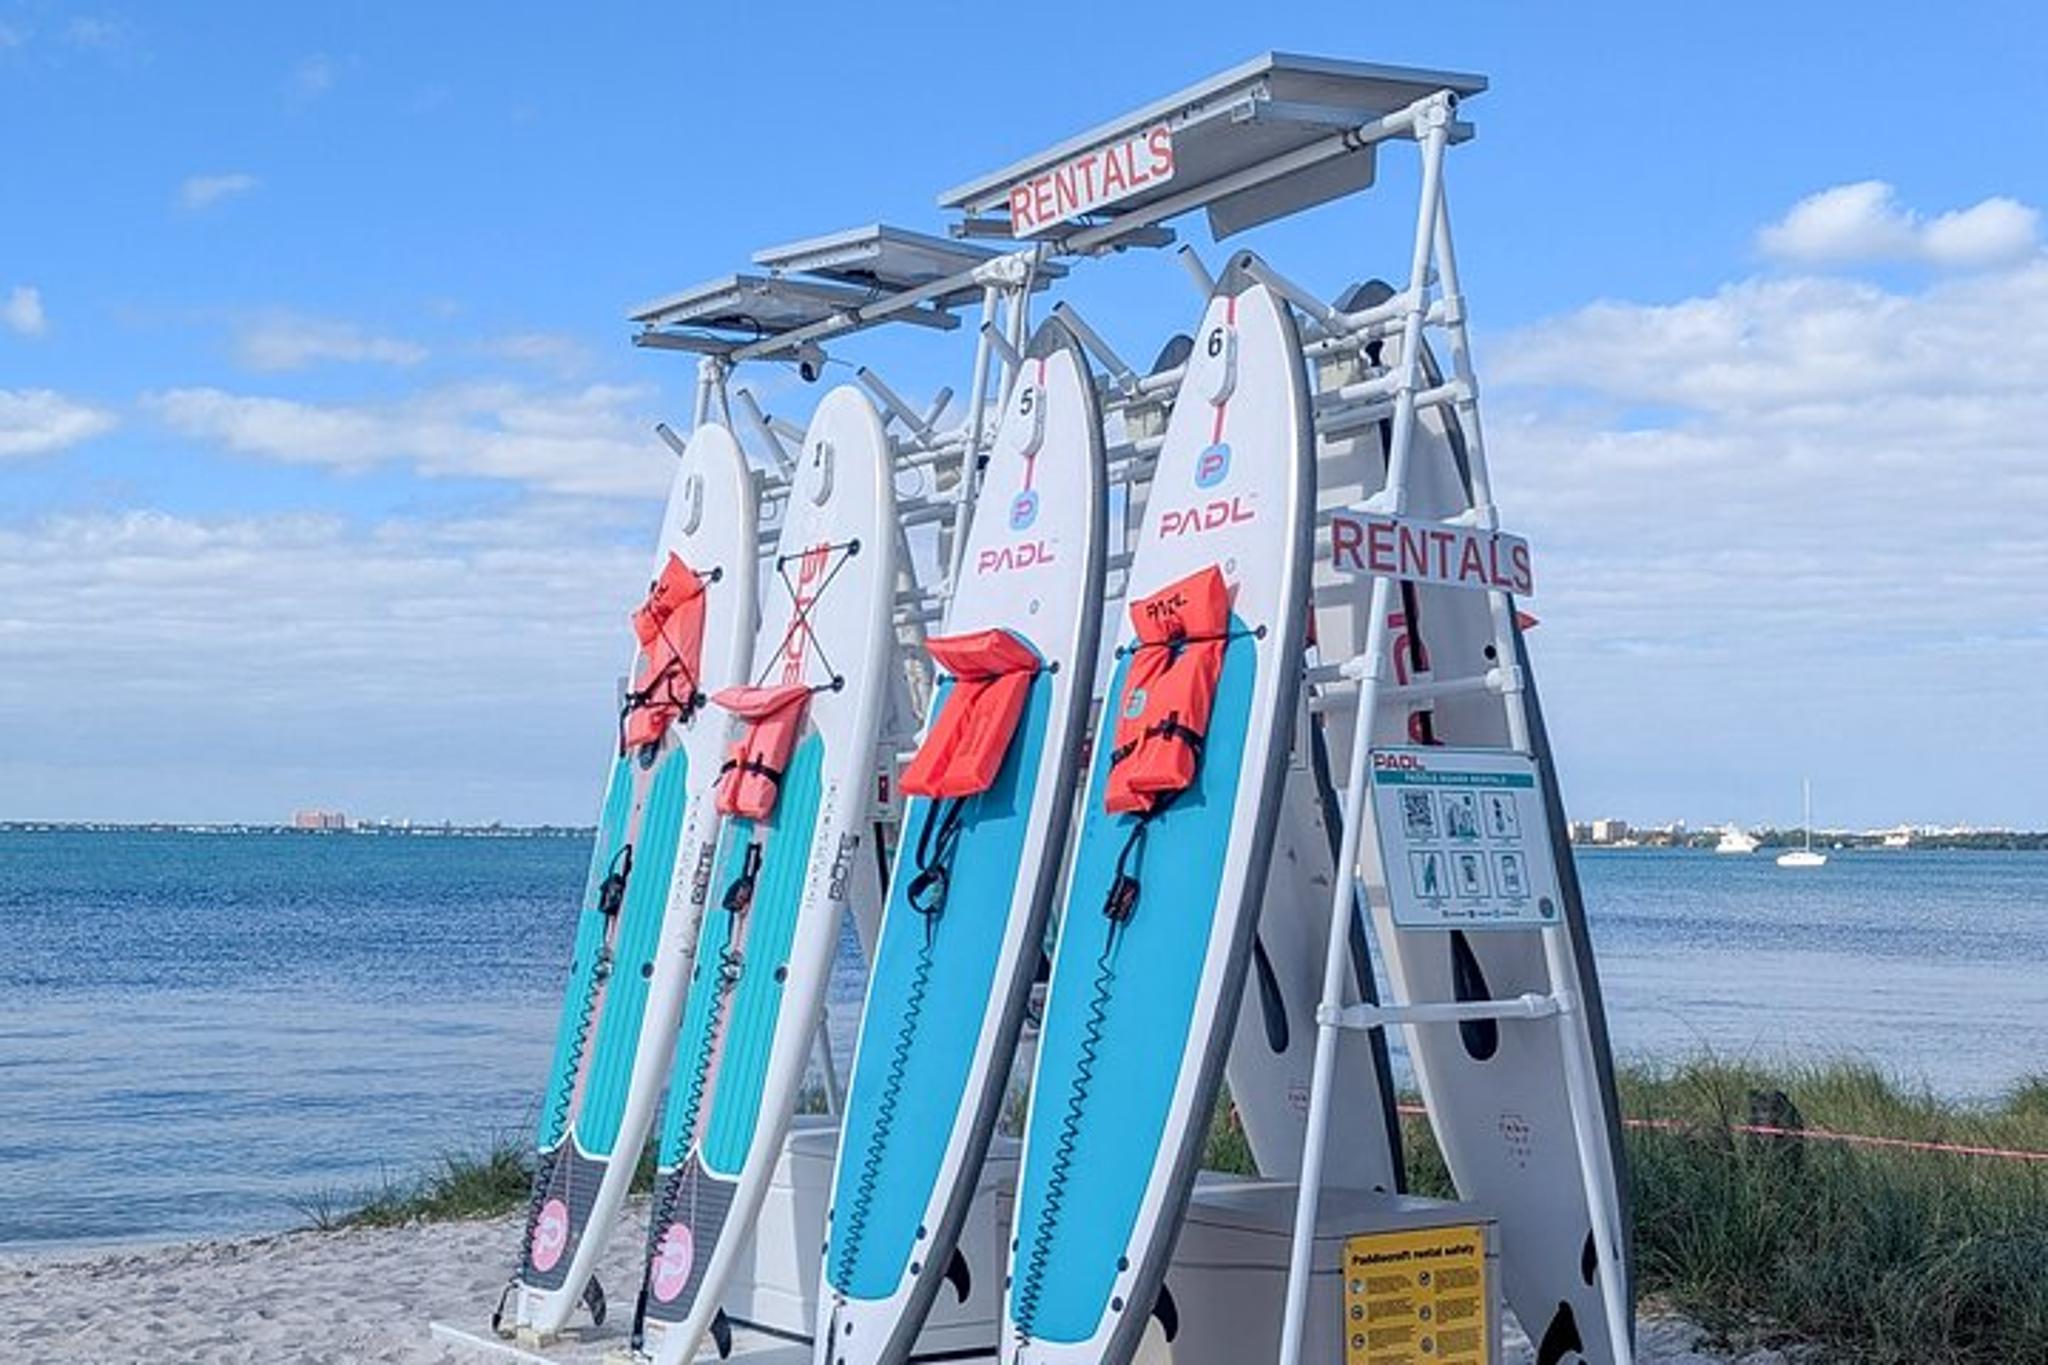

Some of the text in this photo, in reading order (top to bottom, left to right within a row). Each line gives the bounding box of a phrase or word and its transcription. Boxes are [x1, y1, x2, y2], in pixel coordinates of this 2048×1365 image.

[1010, 127, 1173, 232] RENTALS
[1208, 327, 1223, 357] 6
[1020, 387, 1033, 415] 5
[1160, 497, 1255, 538] PADL
[978, 541, 1055, 575] PADL
[1332, 517, 1532, 591] RENTALS
[1373, 753, 1425, 770] PADL
